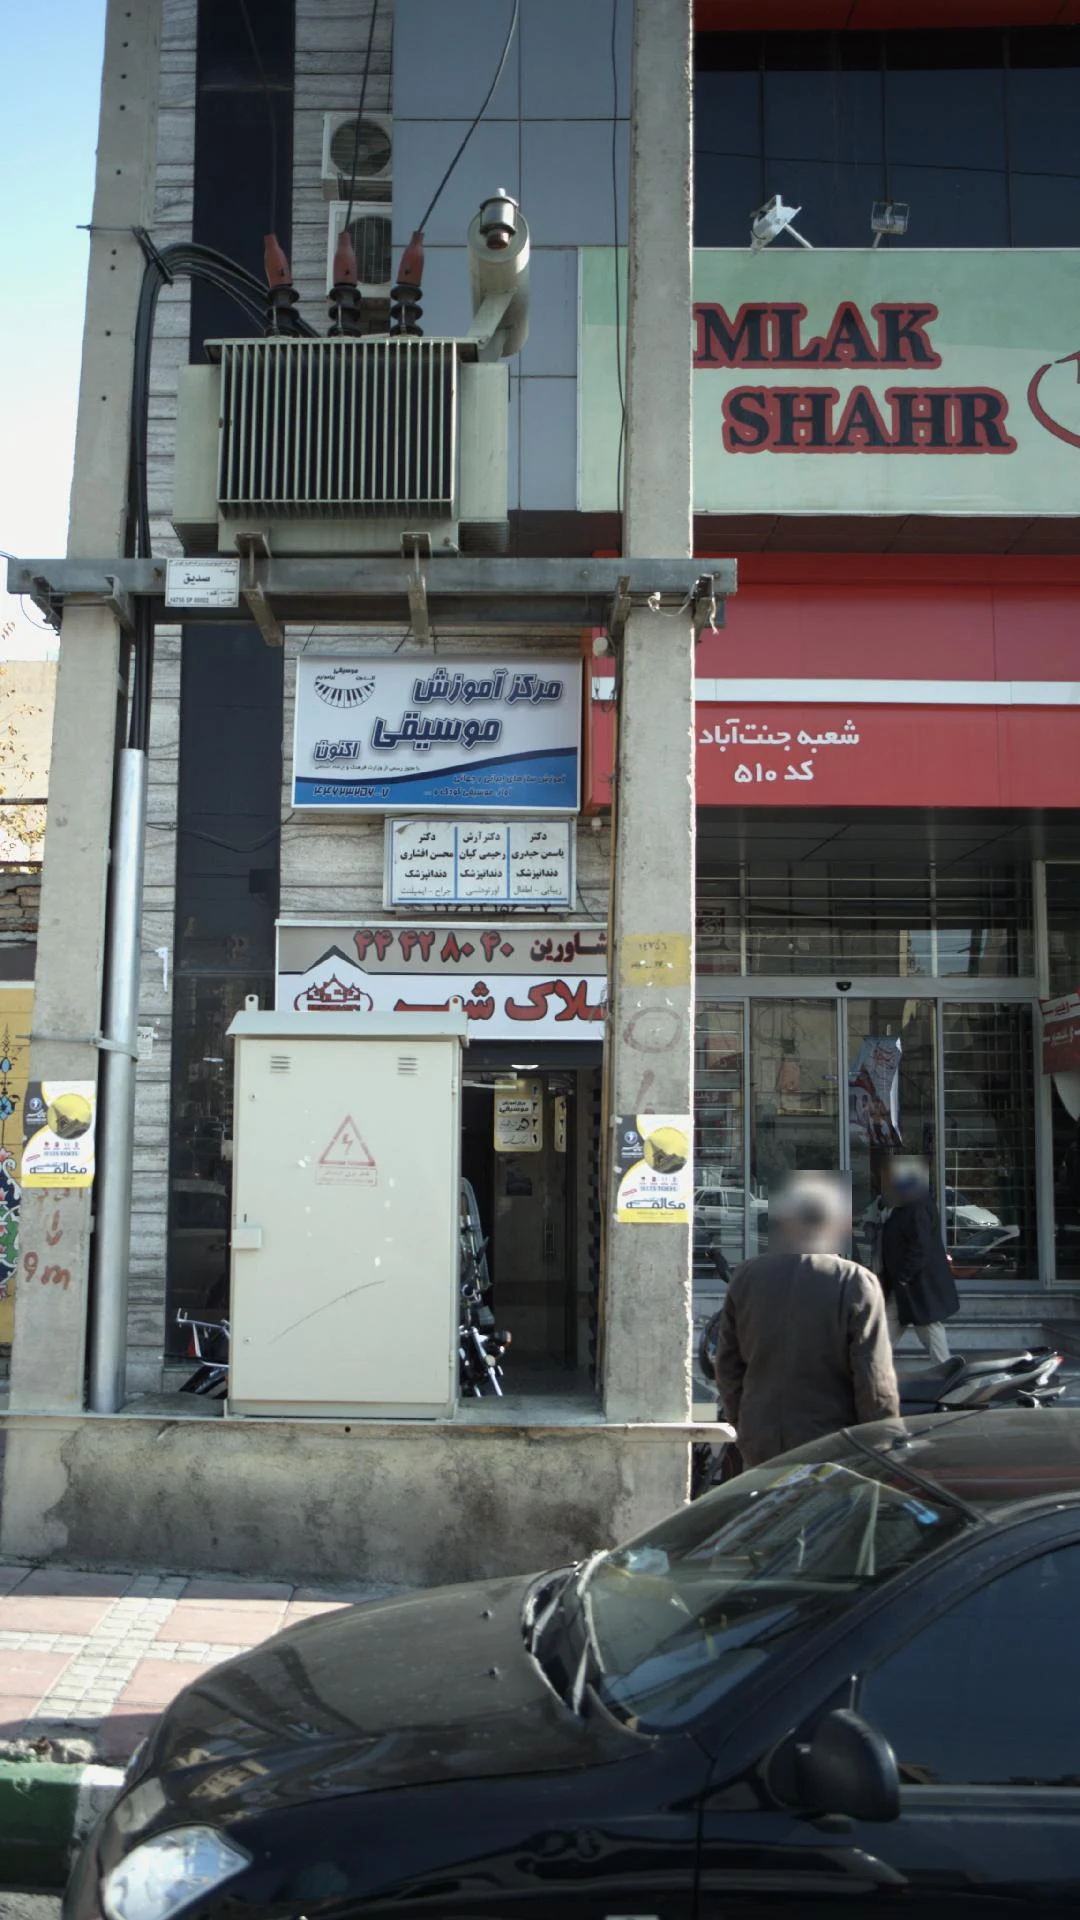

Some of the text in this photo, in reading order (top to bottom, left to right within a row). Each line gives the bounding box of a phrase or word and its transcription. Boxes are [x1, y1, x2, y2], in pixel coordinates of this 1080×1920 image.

[721, 385, 1018, 454] SHAHR
[413, 667, 563, 705] مرکز آموزش
[371, 711, 502, 750] موسیقی
[797, 719, 860, 753] شعبه
[314, 740, 361, 761] اکنون
[734, 760, 814, 783] کد ۵۱۰
[418, 832, 436, 843] دکتر
[462, 831, 501, 843] دکتر آرش
[529, 832, 548, 843] دکتر
[400, 849, 454, 860] محسن افشاری
[459, 848, 506, 860] رحیمی کیان
[511, 848, 564, 860] یاسمن حیدری
[405, 869, 448, 881] دندانپزشک
[459, 869, 503, 880] دندانپزشک
[516, 869, 559, 880] دندانپزشک
[435, 886, 452, 897] جراح
[513, 886, 533, 896] اطفال
[504, 979, 607, 1021] لاک
[30, 1162, 87, 1174] مکالمه
[626, 1197, 686, 1209] مکالمه
